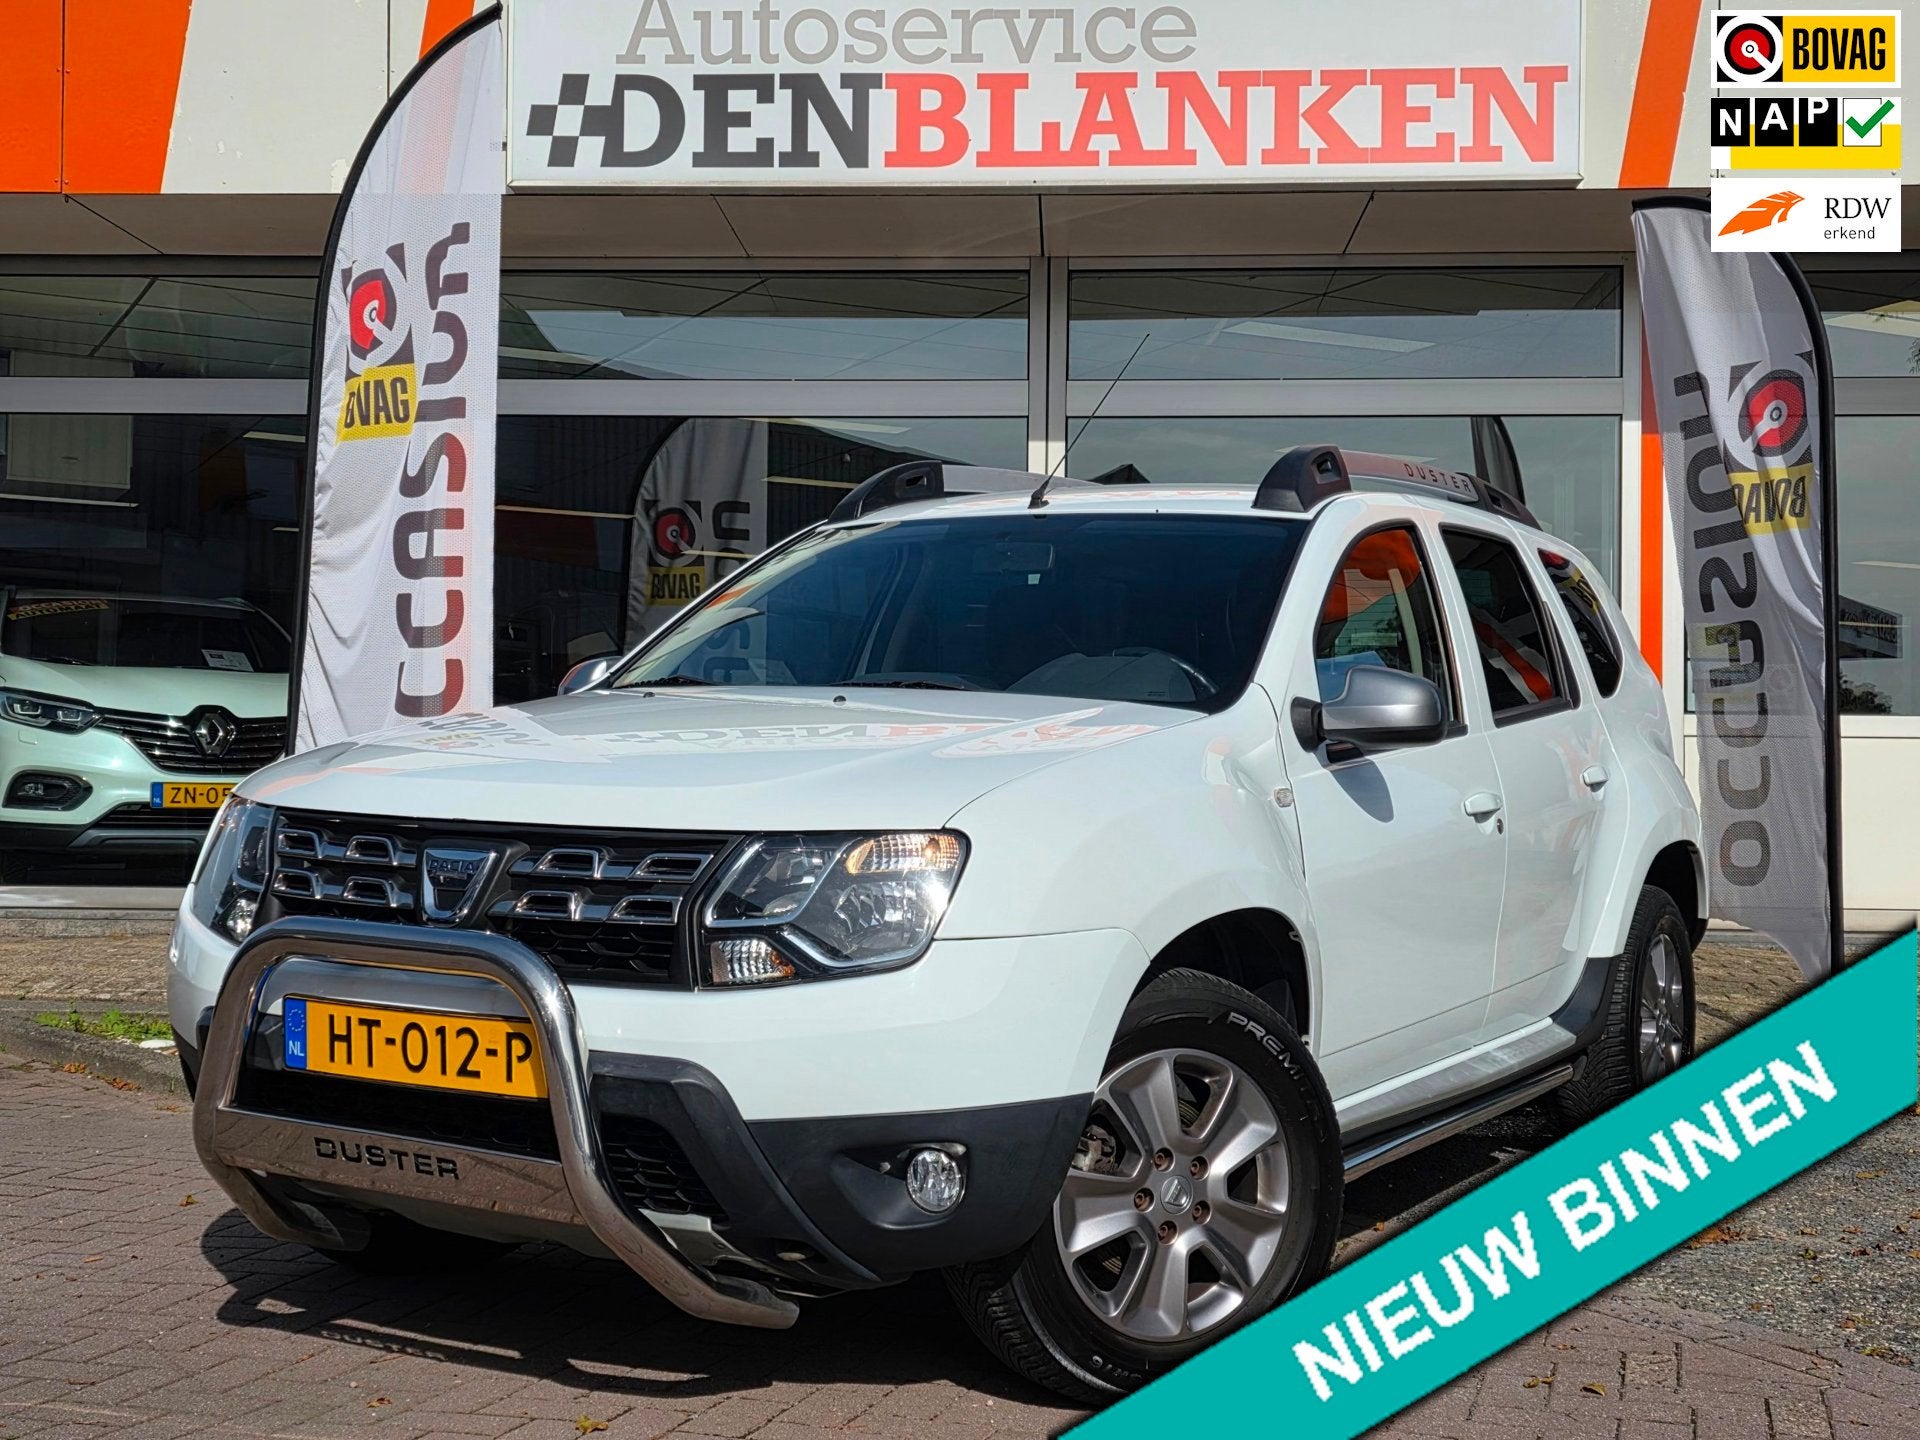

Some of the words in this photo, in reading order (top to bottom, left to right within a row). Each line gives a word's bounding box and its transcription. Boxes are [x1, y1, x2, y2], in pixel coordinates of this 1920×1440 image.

[616, 0, 1196, 64] Autoservice
[1403, 463, 1472, 493] DUSTER
[288, 1040, 305, 1057] NL
[328, 1014, 533, 1083] HT-012-P
[314, 1136, 460, 1180] DUSTER
